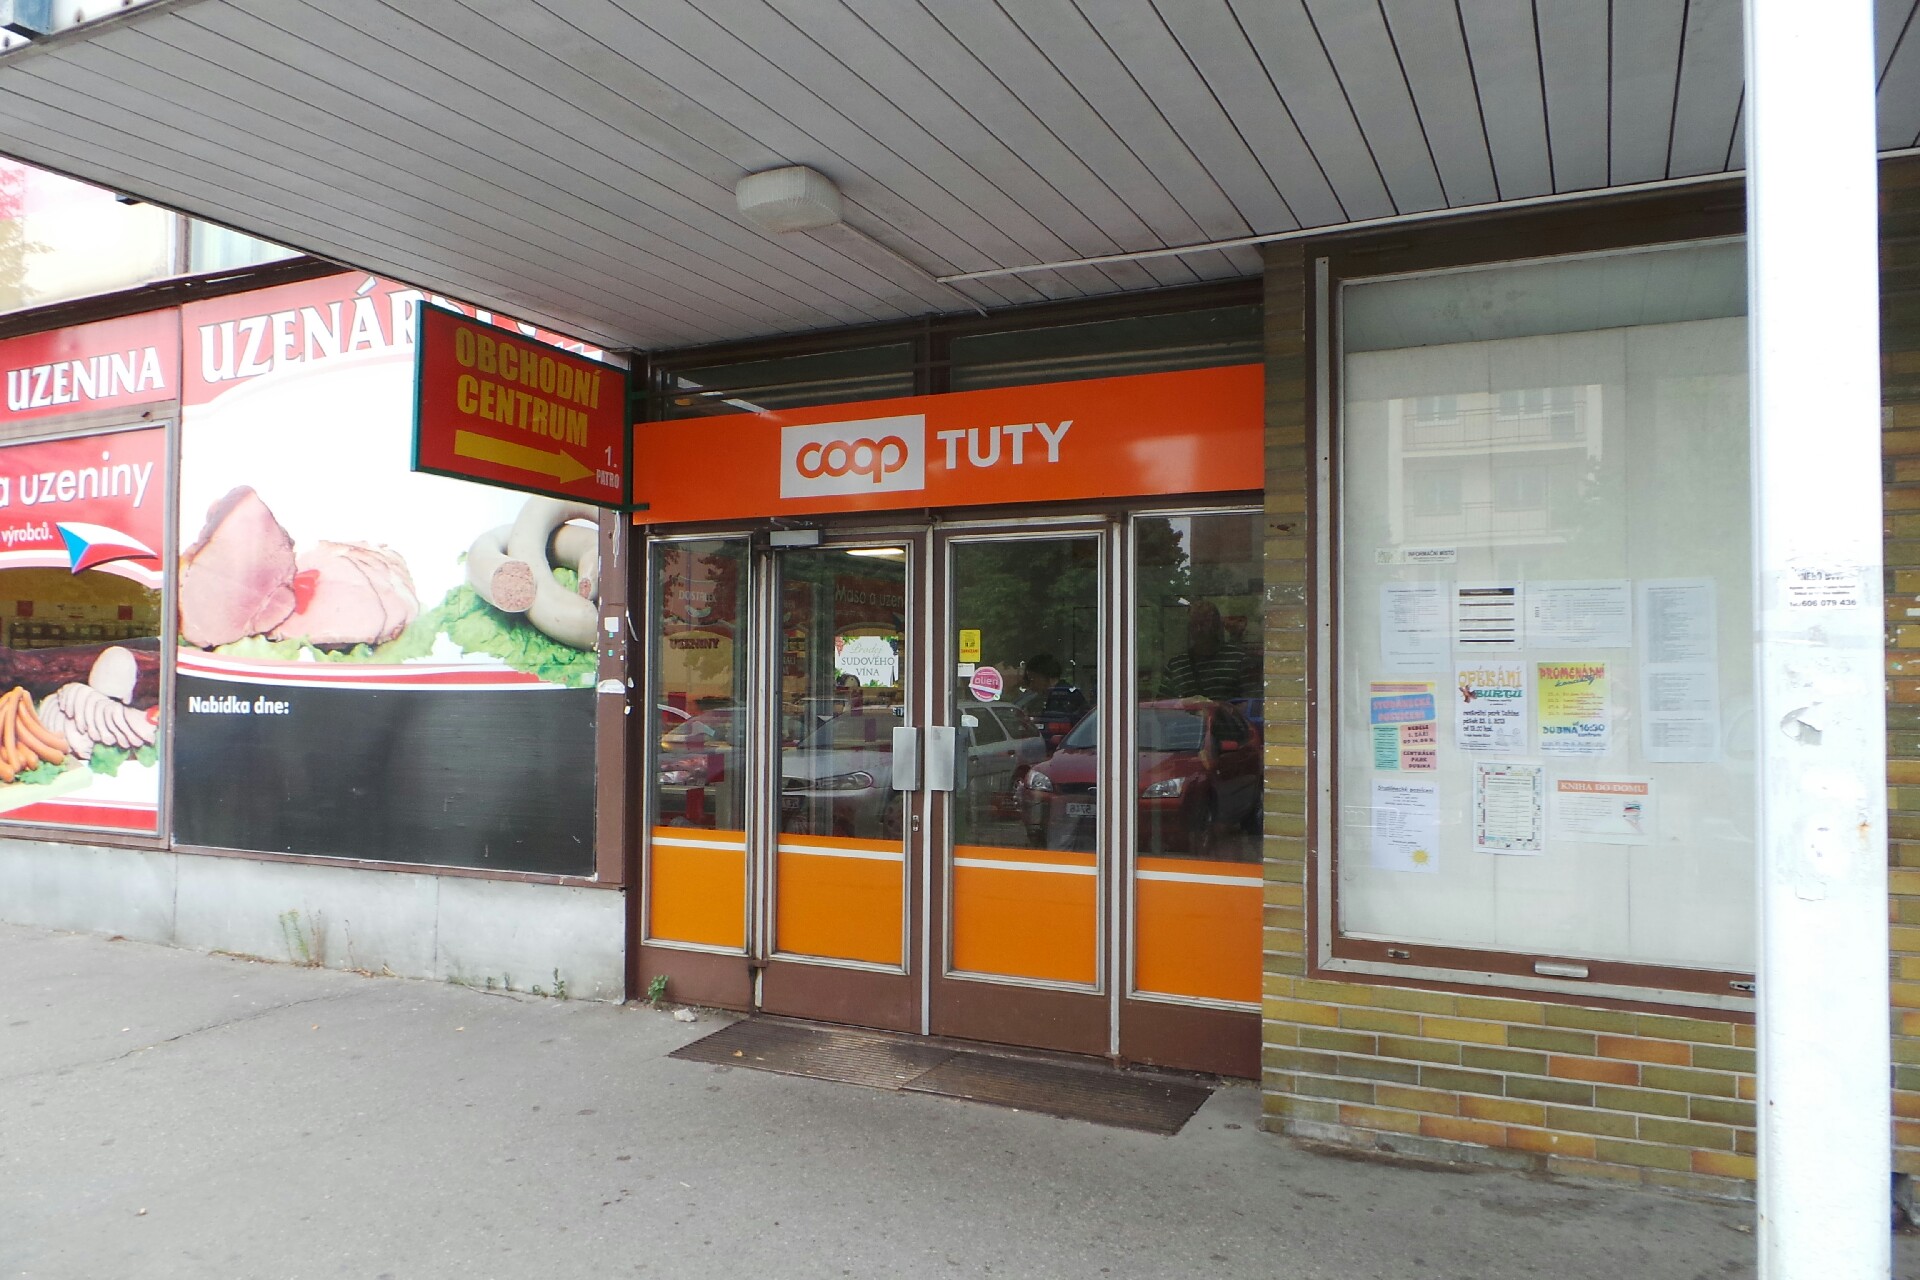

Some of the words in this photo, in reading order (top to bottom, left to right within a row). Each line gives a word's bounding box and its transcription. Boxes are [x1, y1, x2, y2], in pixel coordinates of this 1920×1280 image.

[6, 346, 165, 412] UZENINA
[455, 326, 602, 410] OBCHODNÍ
[457, 374, 588, 448] CENTRUM
[604, 445, 618, 468] 1.
[796, 435, 908, 483] coop
[937, 420, 1073, 470] TUTY
[19, 450, 154, 508] uzeniny
[595, 468, 620, 490] PATRO
[1, 521, 53, 547] výrobců.
[835, 584, 866, 604] Maso
[668, 637, 720, 650] UZENINY
[841, 655, 895, 666] SUDOVÉHO
[856, 667, 880, 677] VÍNA
[188, 695, 251, 715] Nabídka
[253, 695, 290, 716] dne:
[1542, 726, 1579, 734] DUBINA
[1560, 781, 1593, 791] KNIHA
[1594, 783, 1611, 791] DO
[1613, 784, 1645, 793] DOMU
